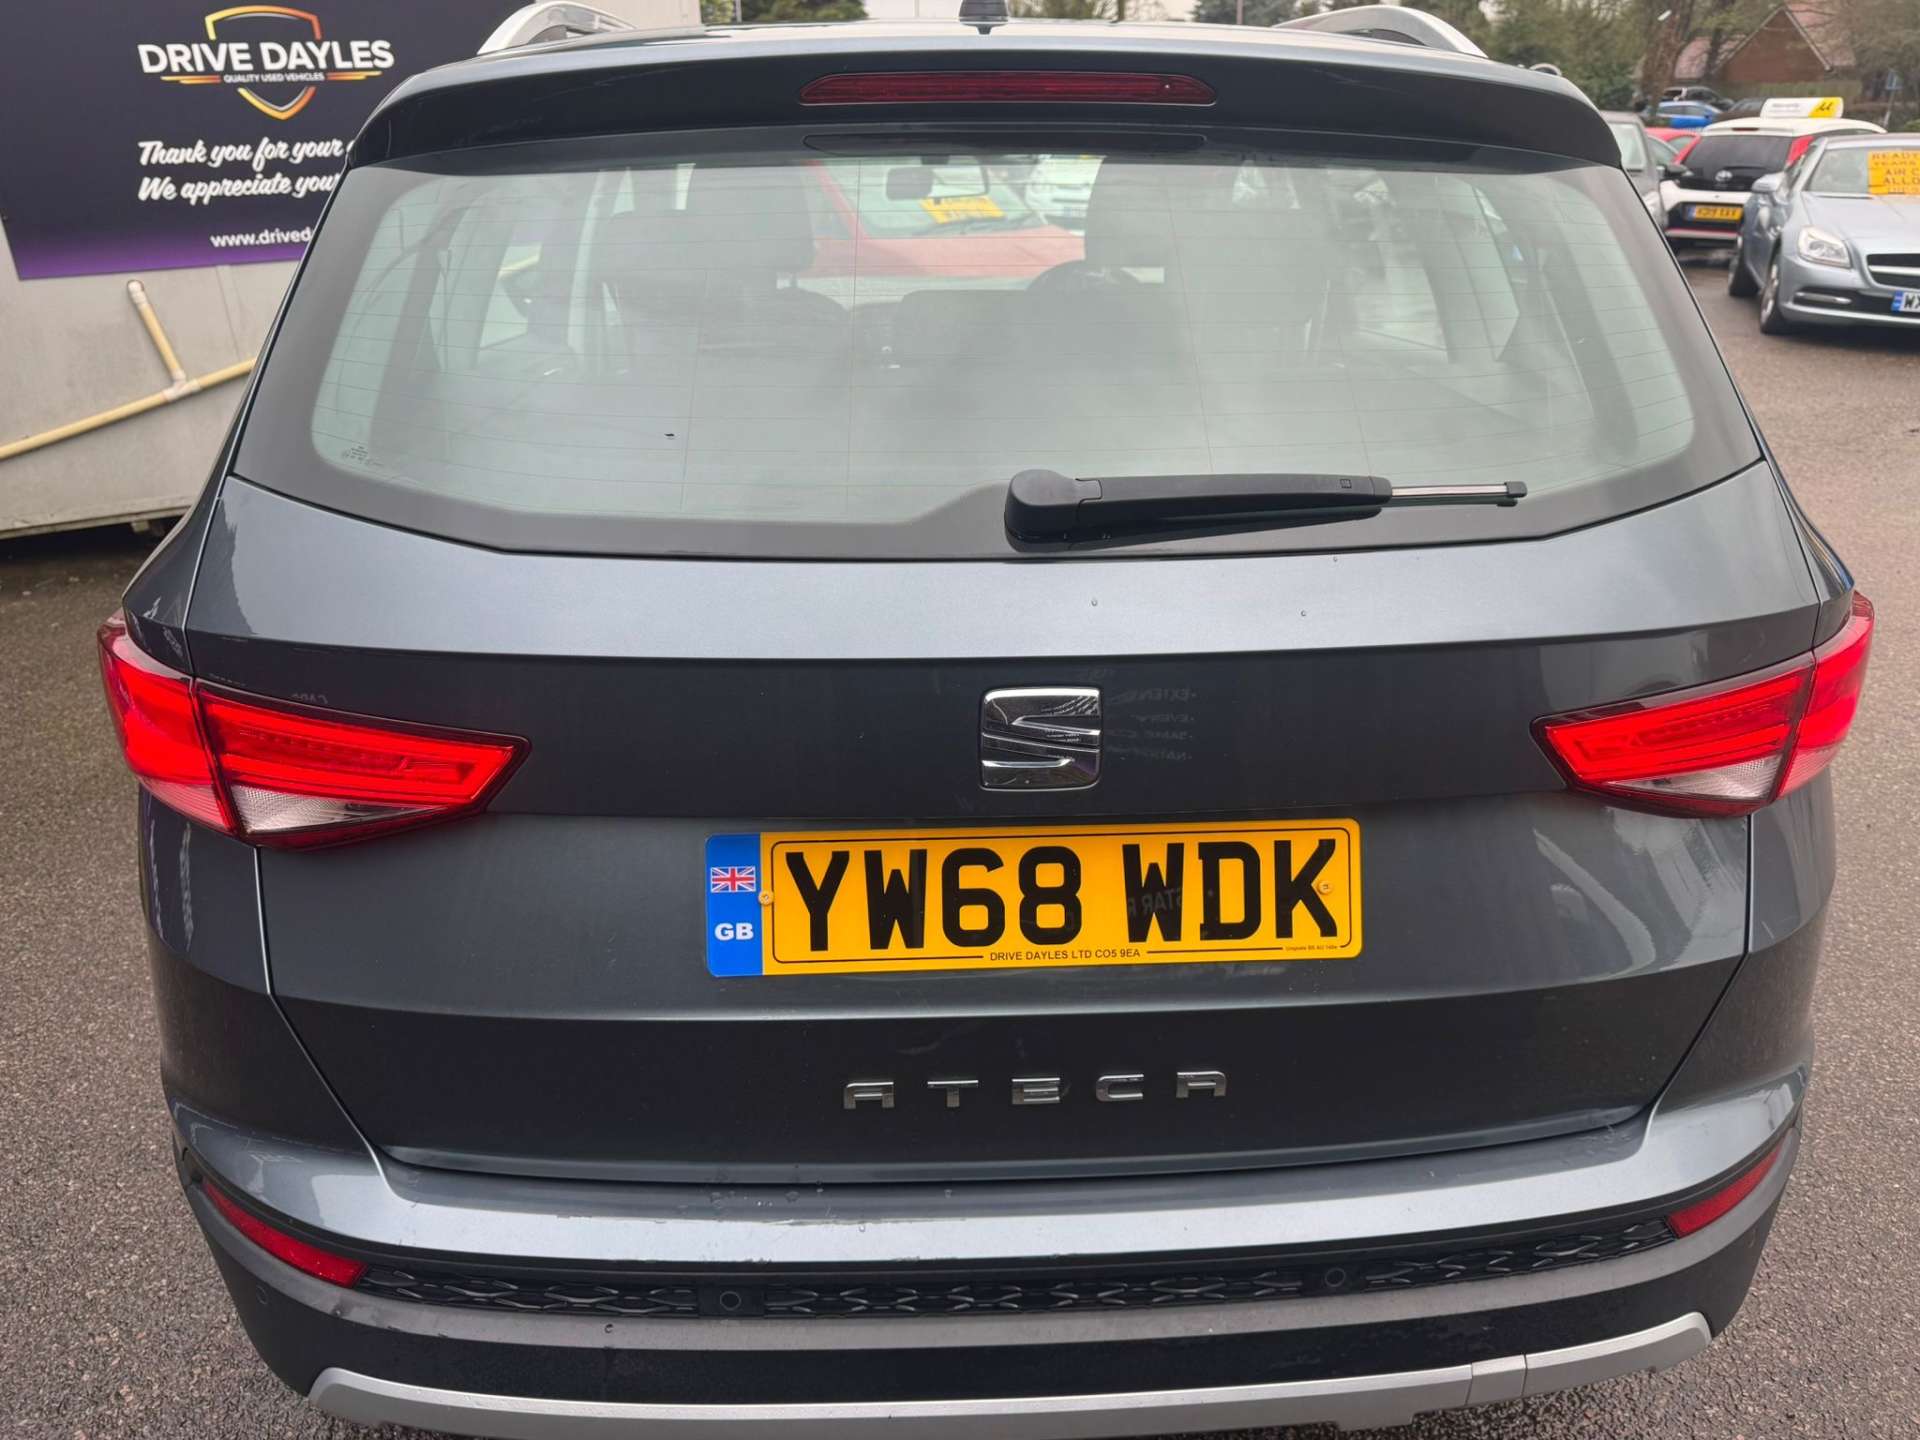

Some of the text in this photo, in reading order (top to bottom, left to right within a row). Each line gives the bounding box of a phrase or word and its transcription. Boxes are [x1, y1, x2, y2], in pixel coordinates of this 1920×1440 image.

[137, 39, 395, 74] DRIVE DAYLES
[223, 72, 325, 84] QUALITY USED VEHICLES
[138, 139, 207, 166] Thank
[207, 144, 251, 168] you
[251, 136, 290, 172] for
[289, 138, 343, 164] your
[138, 176, 177, 201] We
[180, 172, 292, 206] appreciate
[785, 839, 1337, 952] YW68 WDK
[714, 923, 754, 941] GB
[989, 951, 1023, 962] DRIVE
[1025, 950, 1068, 961] DAYLES
[1071, 950, 1092, 960] LTD
[1119, 948, 1141, 958] 9EA
[843, 1070, 1226, 1110] ATECA
